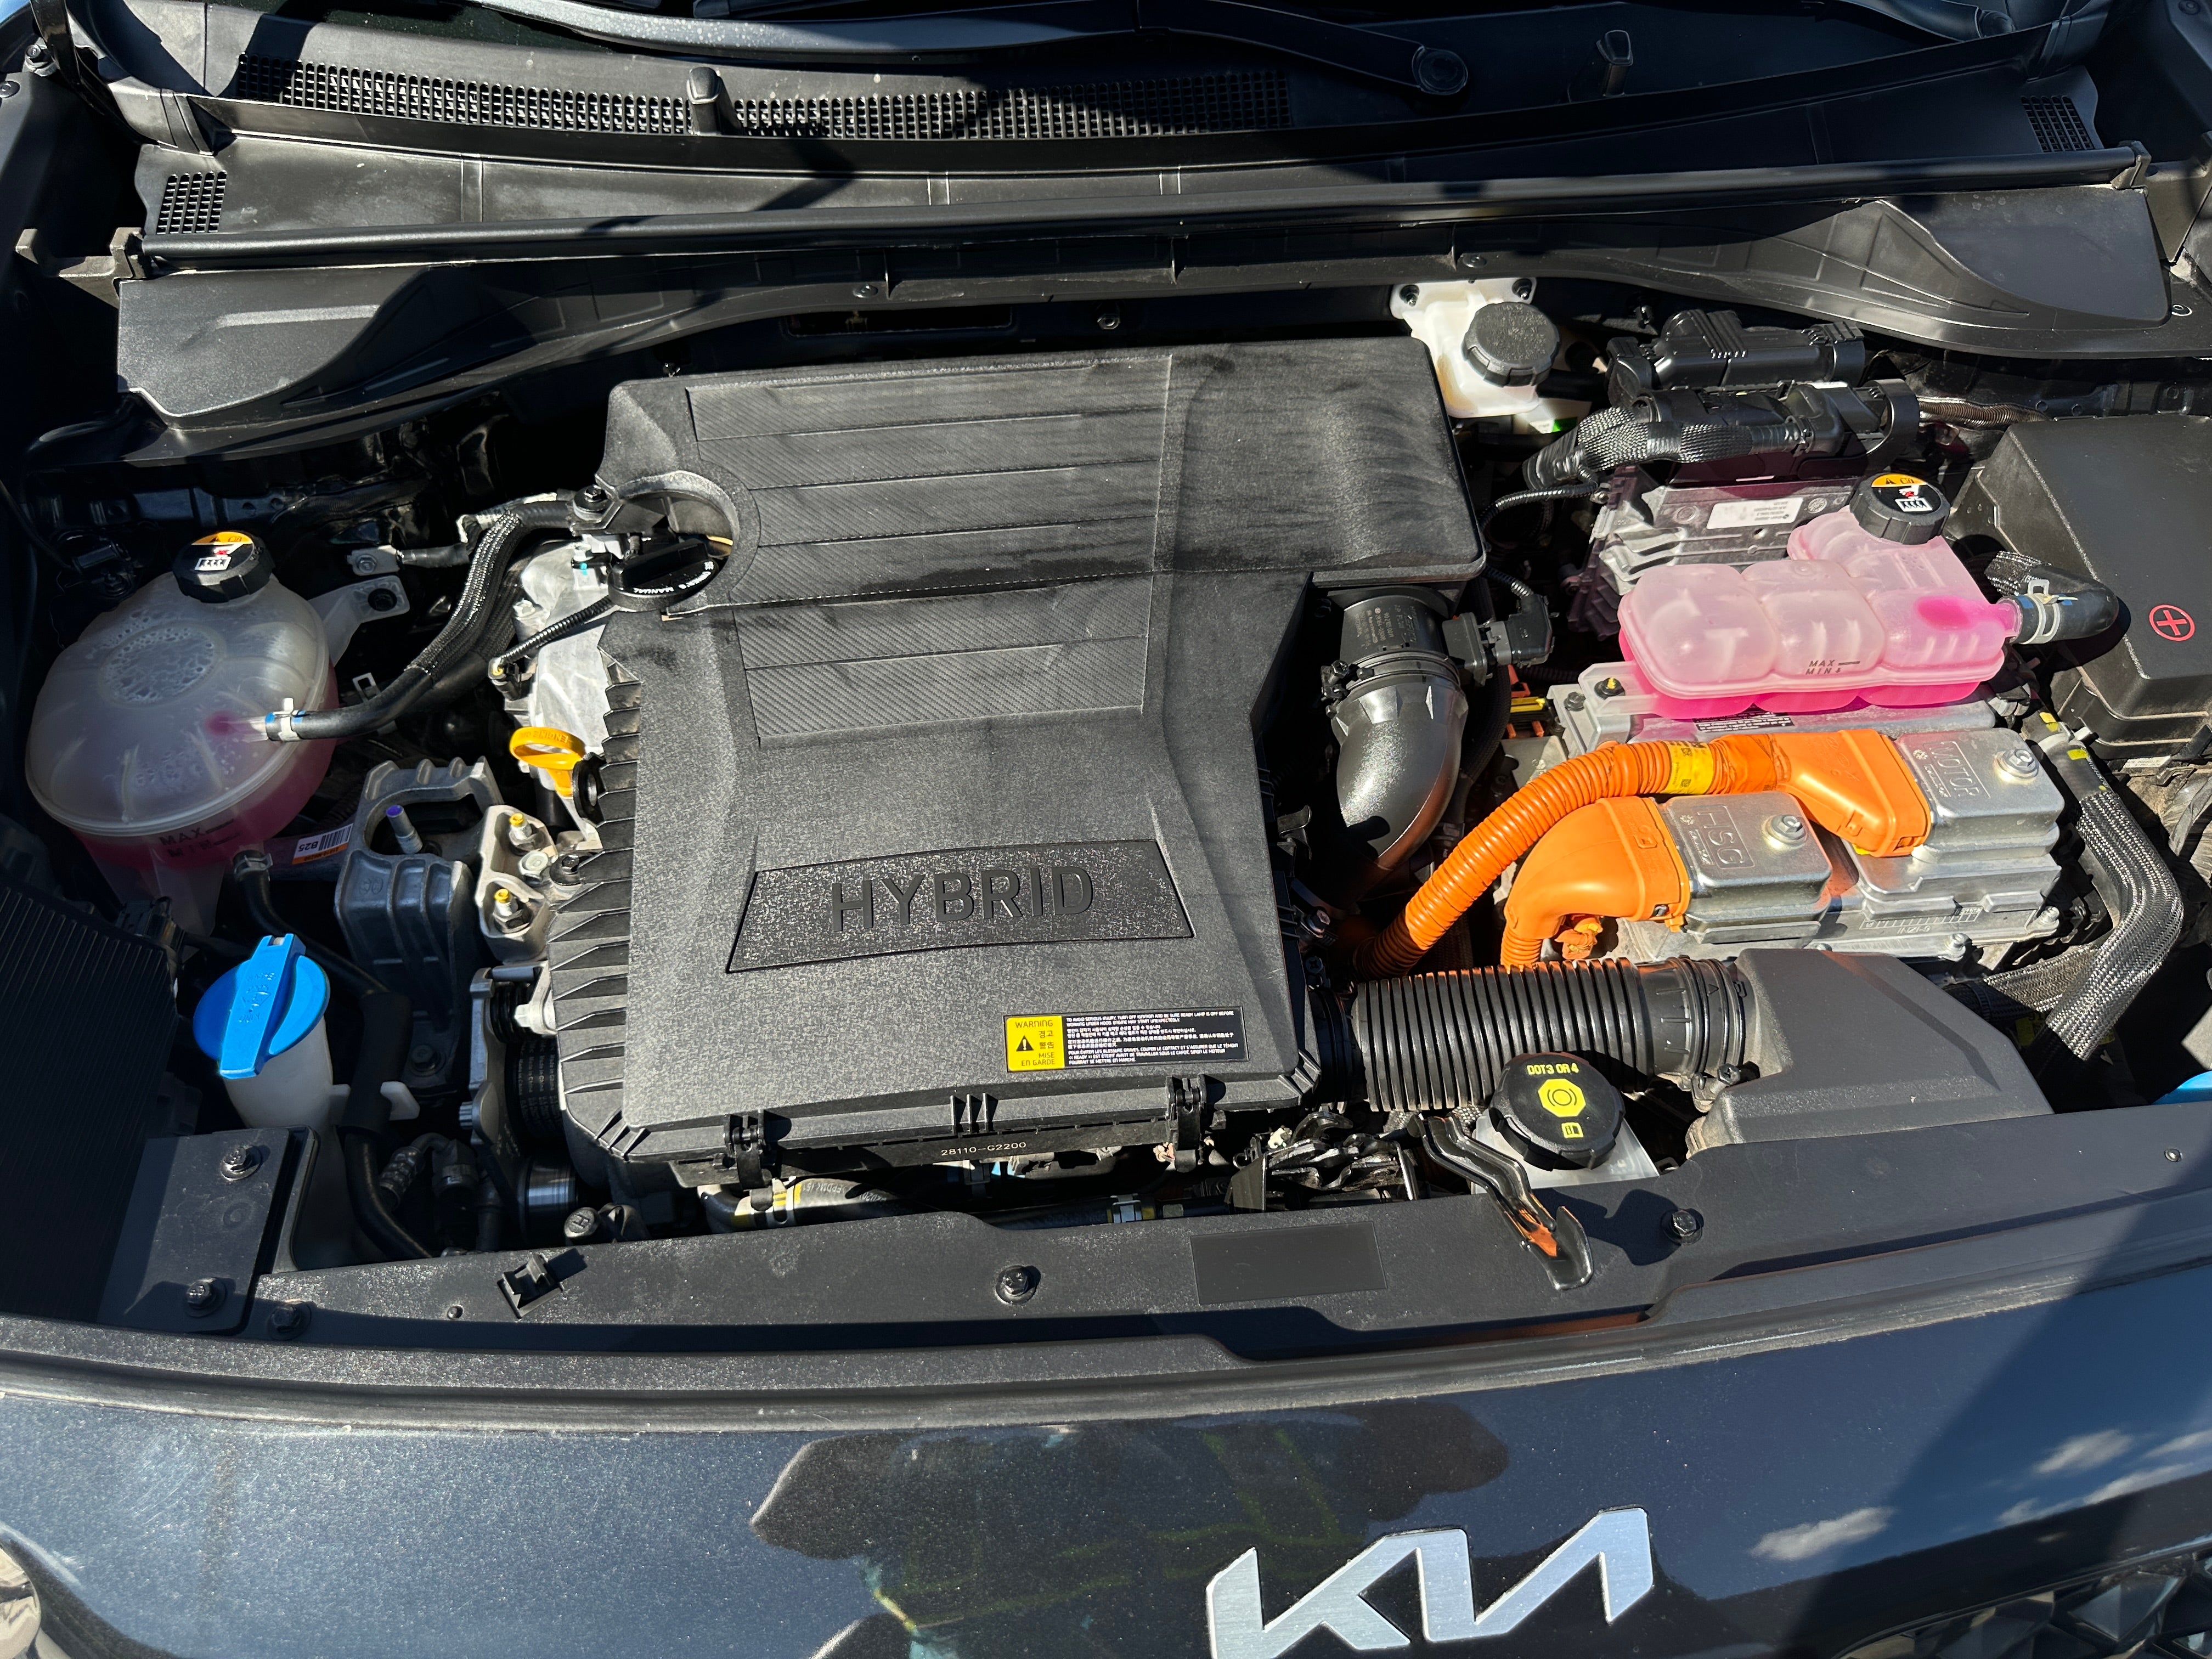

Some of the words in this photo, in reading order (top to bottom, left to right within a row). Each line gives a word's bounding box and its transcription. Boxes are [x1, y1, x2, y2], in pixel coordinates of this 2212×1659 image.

[159, 827, 205, 846] MAX
[298, 841, 319, 853] B25
[832, 866, 1094, 933] HYBRID
[1015, 1019, 1053, 1028] WARNING
[1038, 1030, 1054, 1039] 경고
[1527, 1064, 1555, 1075] DOT3
[1555, 1063, 1571, 1074] OR
[1571, 1063, 1579, 1073] 4
[941, 1141, 1026, 1156] 28110-G2200
